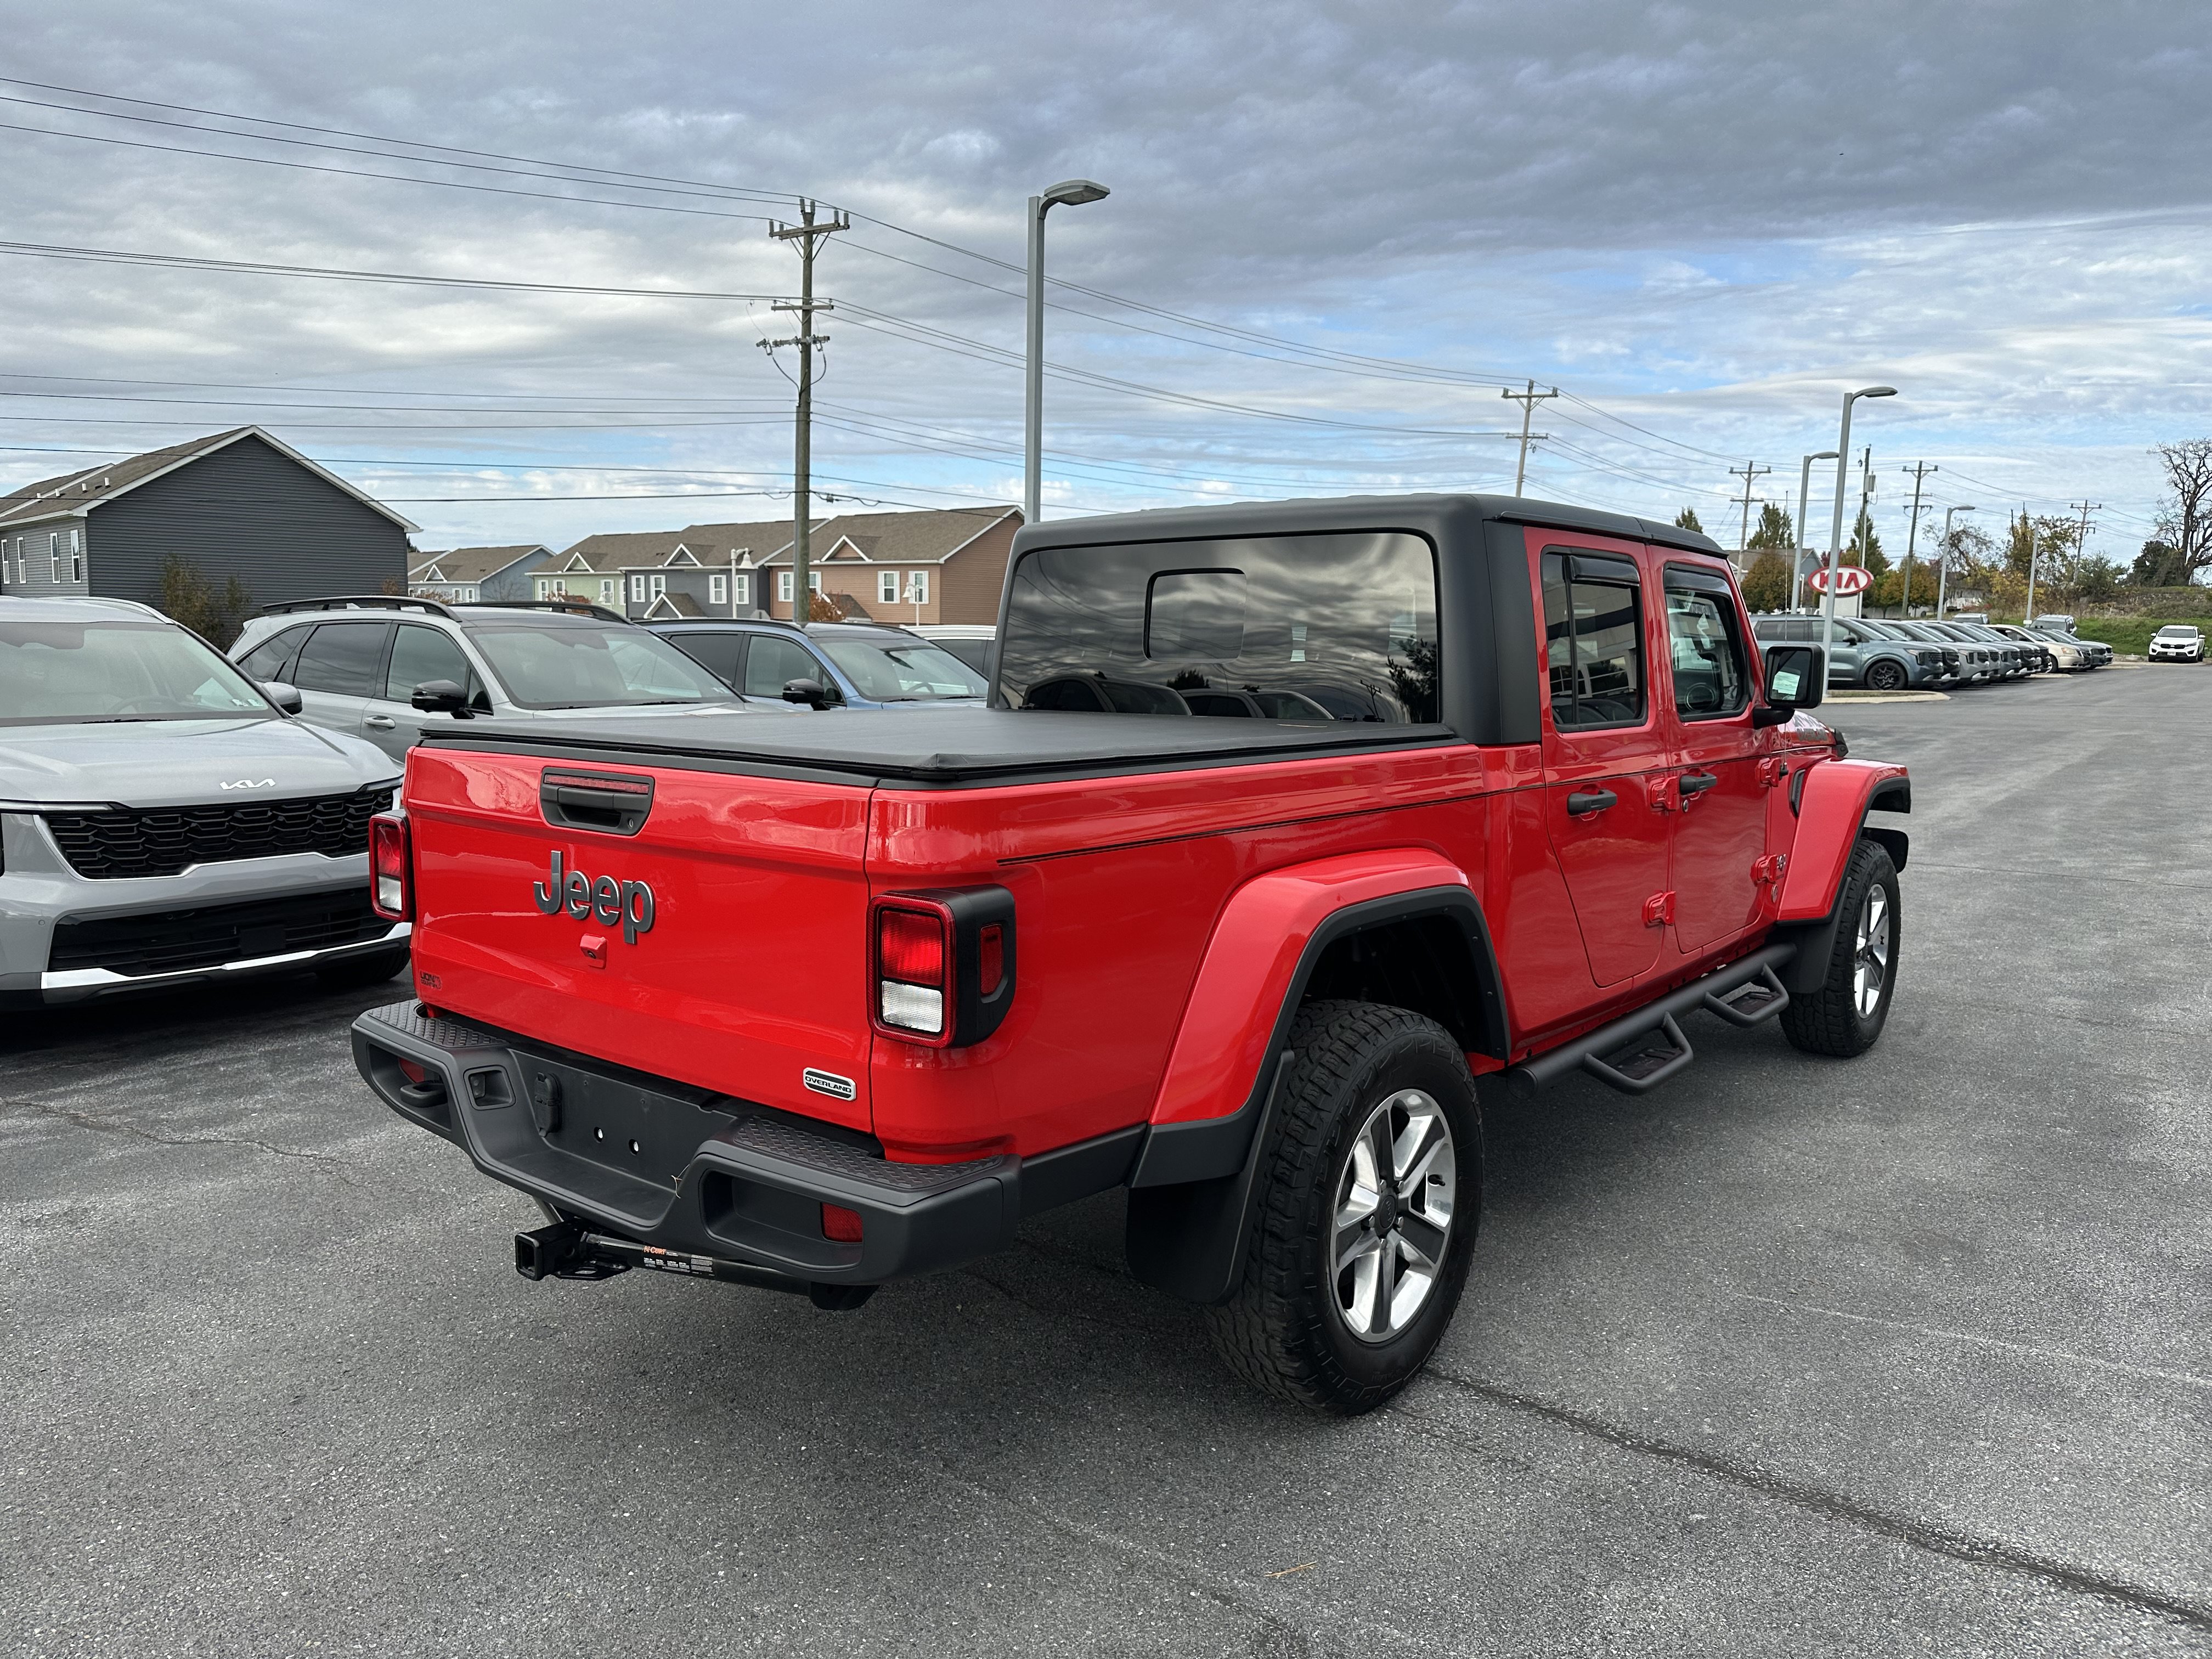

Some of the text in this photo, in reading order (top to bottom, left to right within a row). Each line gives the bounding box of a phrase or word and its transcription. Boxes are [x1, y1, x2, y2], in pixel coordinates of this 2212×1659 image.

[1819, 572, 1860, 589] KIA
[533, 850, 656, 945] Jeep
[805, 1076, 851, 1093] OVERLAND
